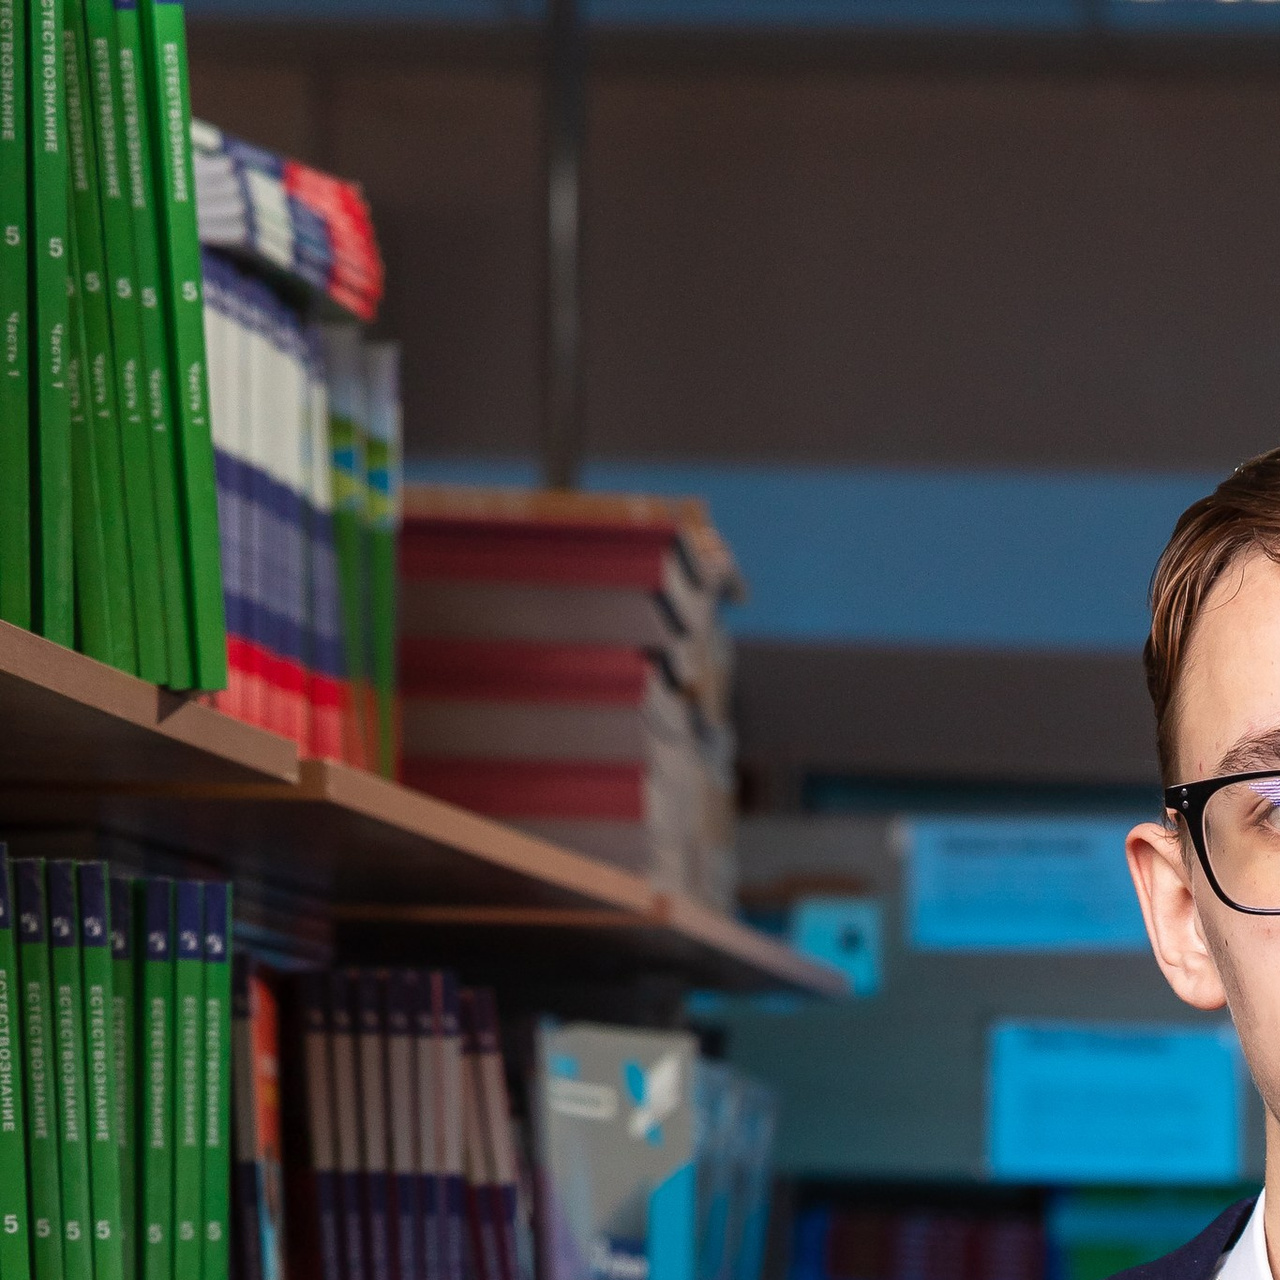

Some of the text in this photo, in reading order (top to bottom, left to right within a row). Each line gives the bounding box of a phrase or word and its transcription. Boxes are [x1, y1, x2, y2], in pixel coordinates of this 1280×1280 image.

[164, 43, 187, 202] ЕСТЕСТВОЗНАНИЕ
[5, 226, 20, 246] 5
[50, 237, 63, 258] 5
[85, 271, 100, 292] 5
[116, 278, 132, 298] 5
[182, 281, 198, 301] 5
[90, 984, 109, 1142] ЕСТЕСТВОЗНАНИЕ
[4, 1214, 18, 1234] 5
[36, 1218, 50, 1238] 5
[66, 1221, 80, 1240] 5
[96, 1219, 110, 1240] 5
